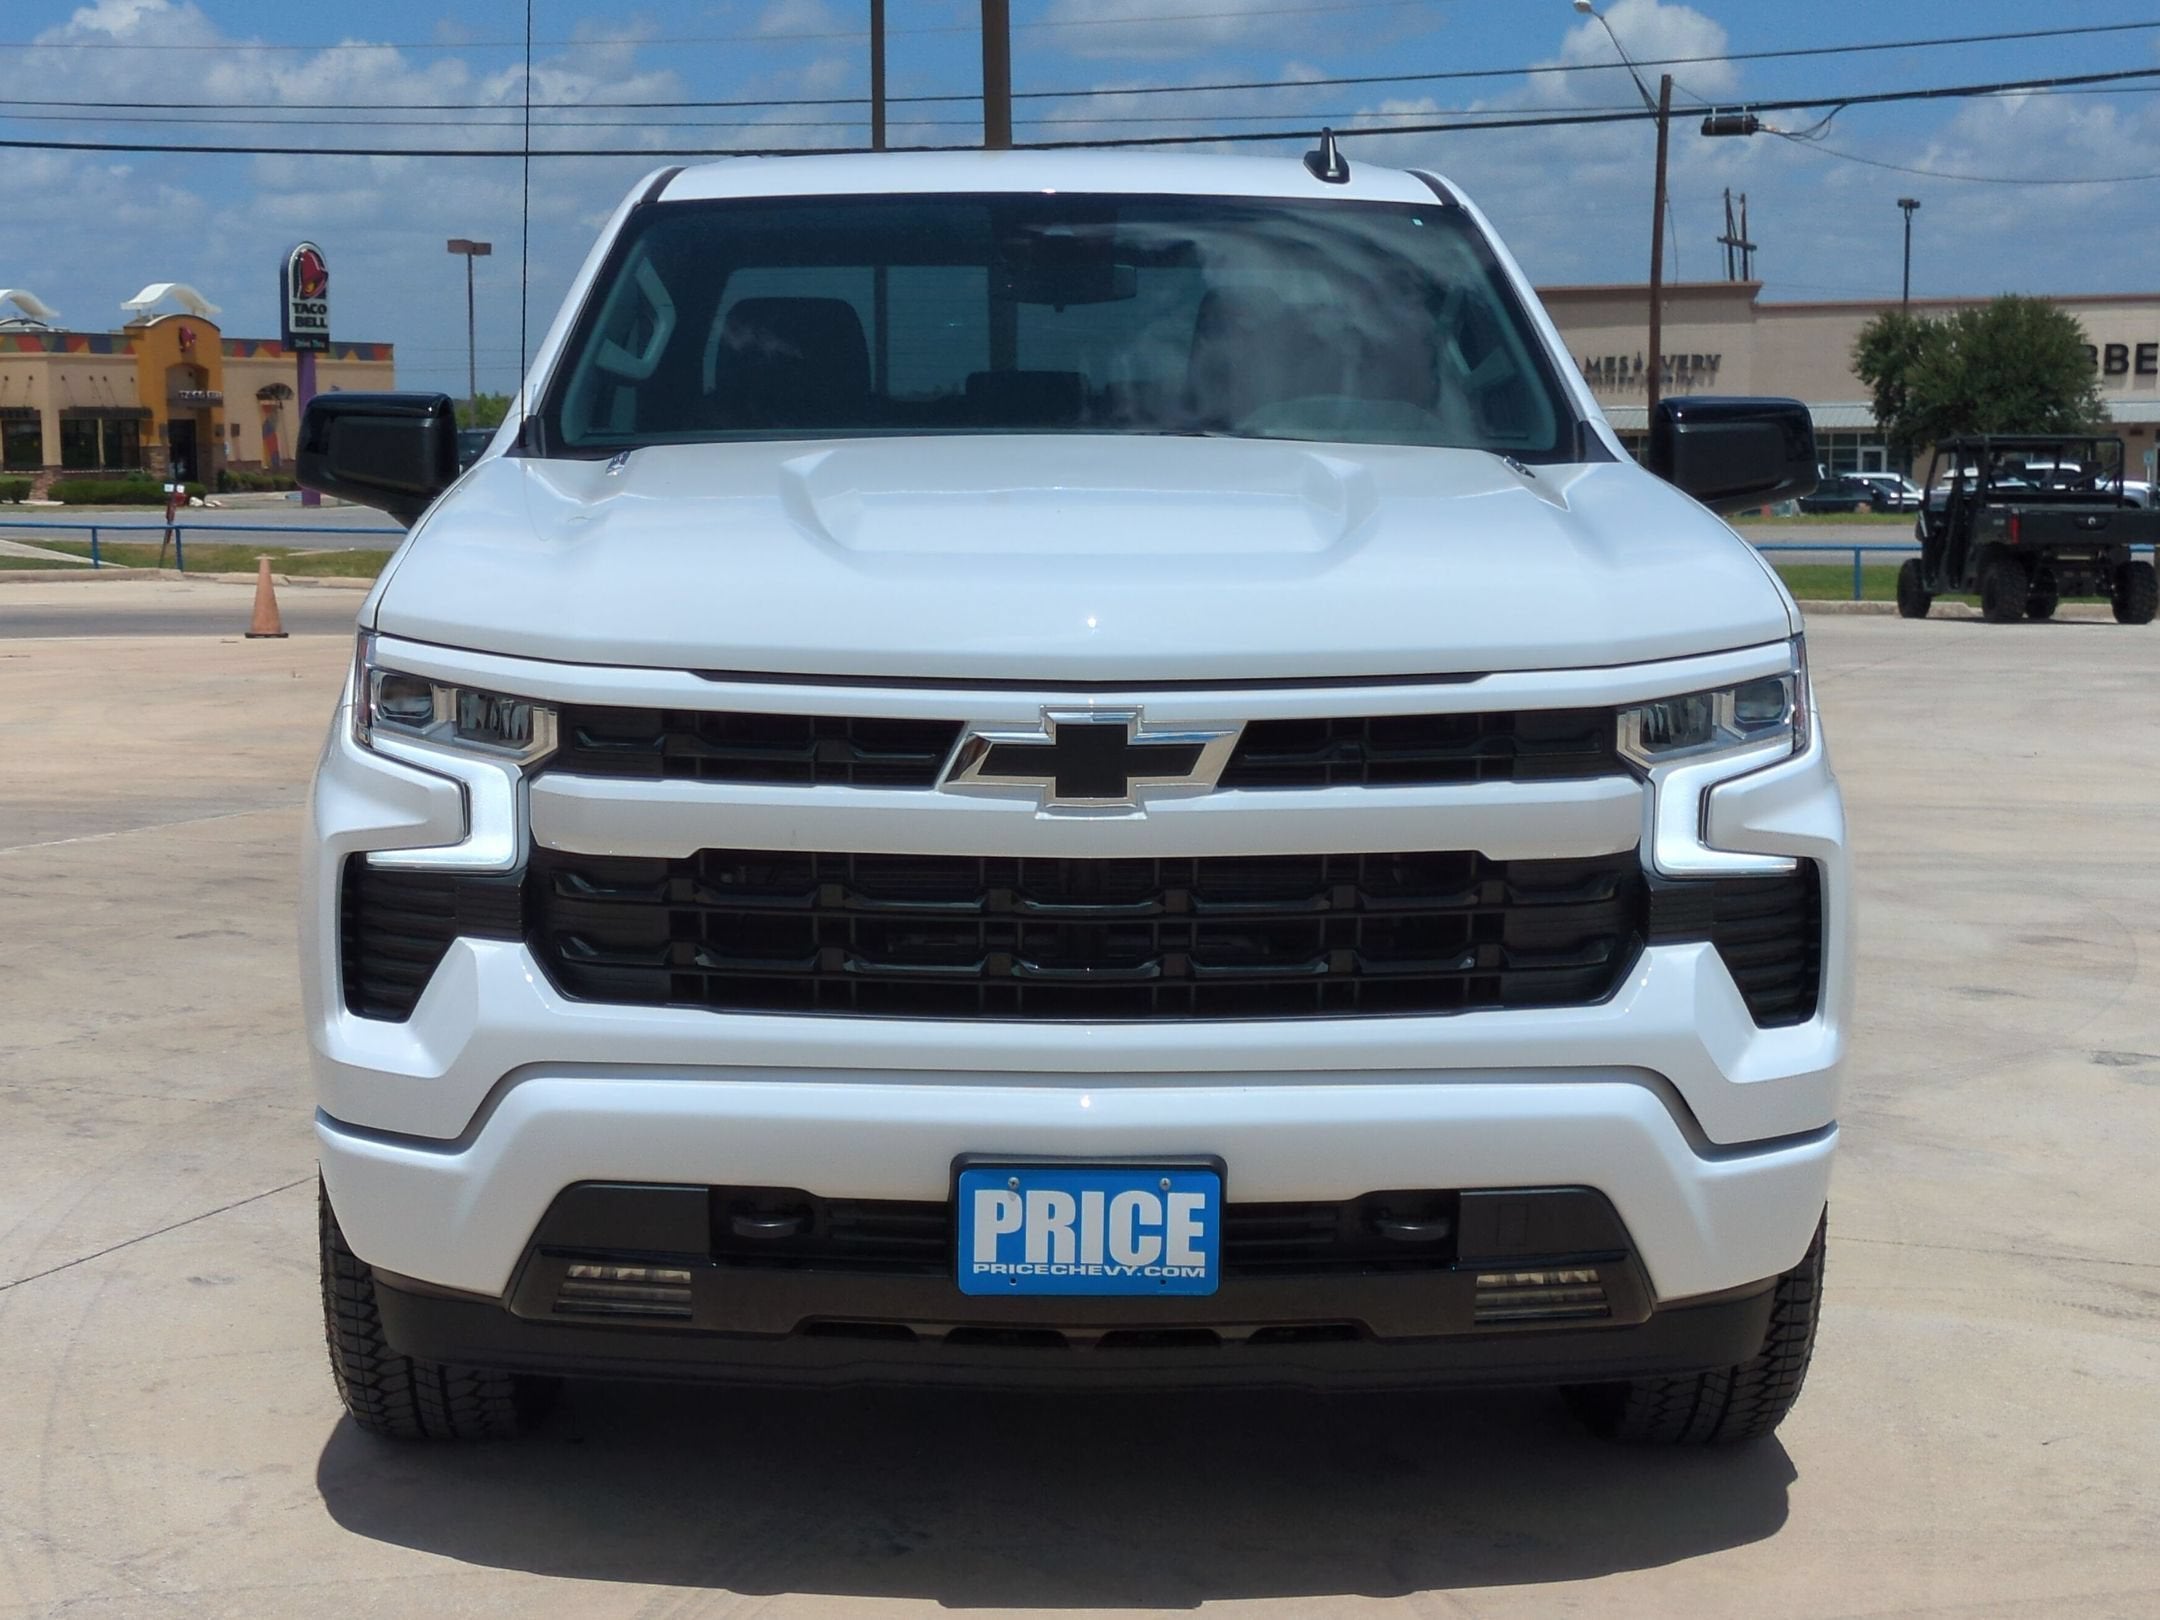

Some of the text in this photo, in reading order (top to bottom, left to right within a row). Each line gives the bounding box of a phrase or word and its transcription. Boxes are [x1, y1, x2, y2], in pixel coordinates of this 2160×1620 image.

[292, 302, 328, 315] TACO
[295, 316, 328, 328] BELL
[1647, 354, 1721, 372] VERY
[973, 1189, 1205, 1267] PRICE
[973, 1263, 1206, 1278] PRICECHEVY.COM
